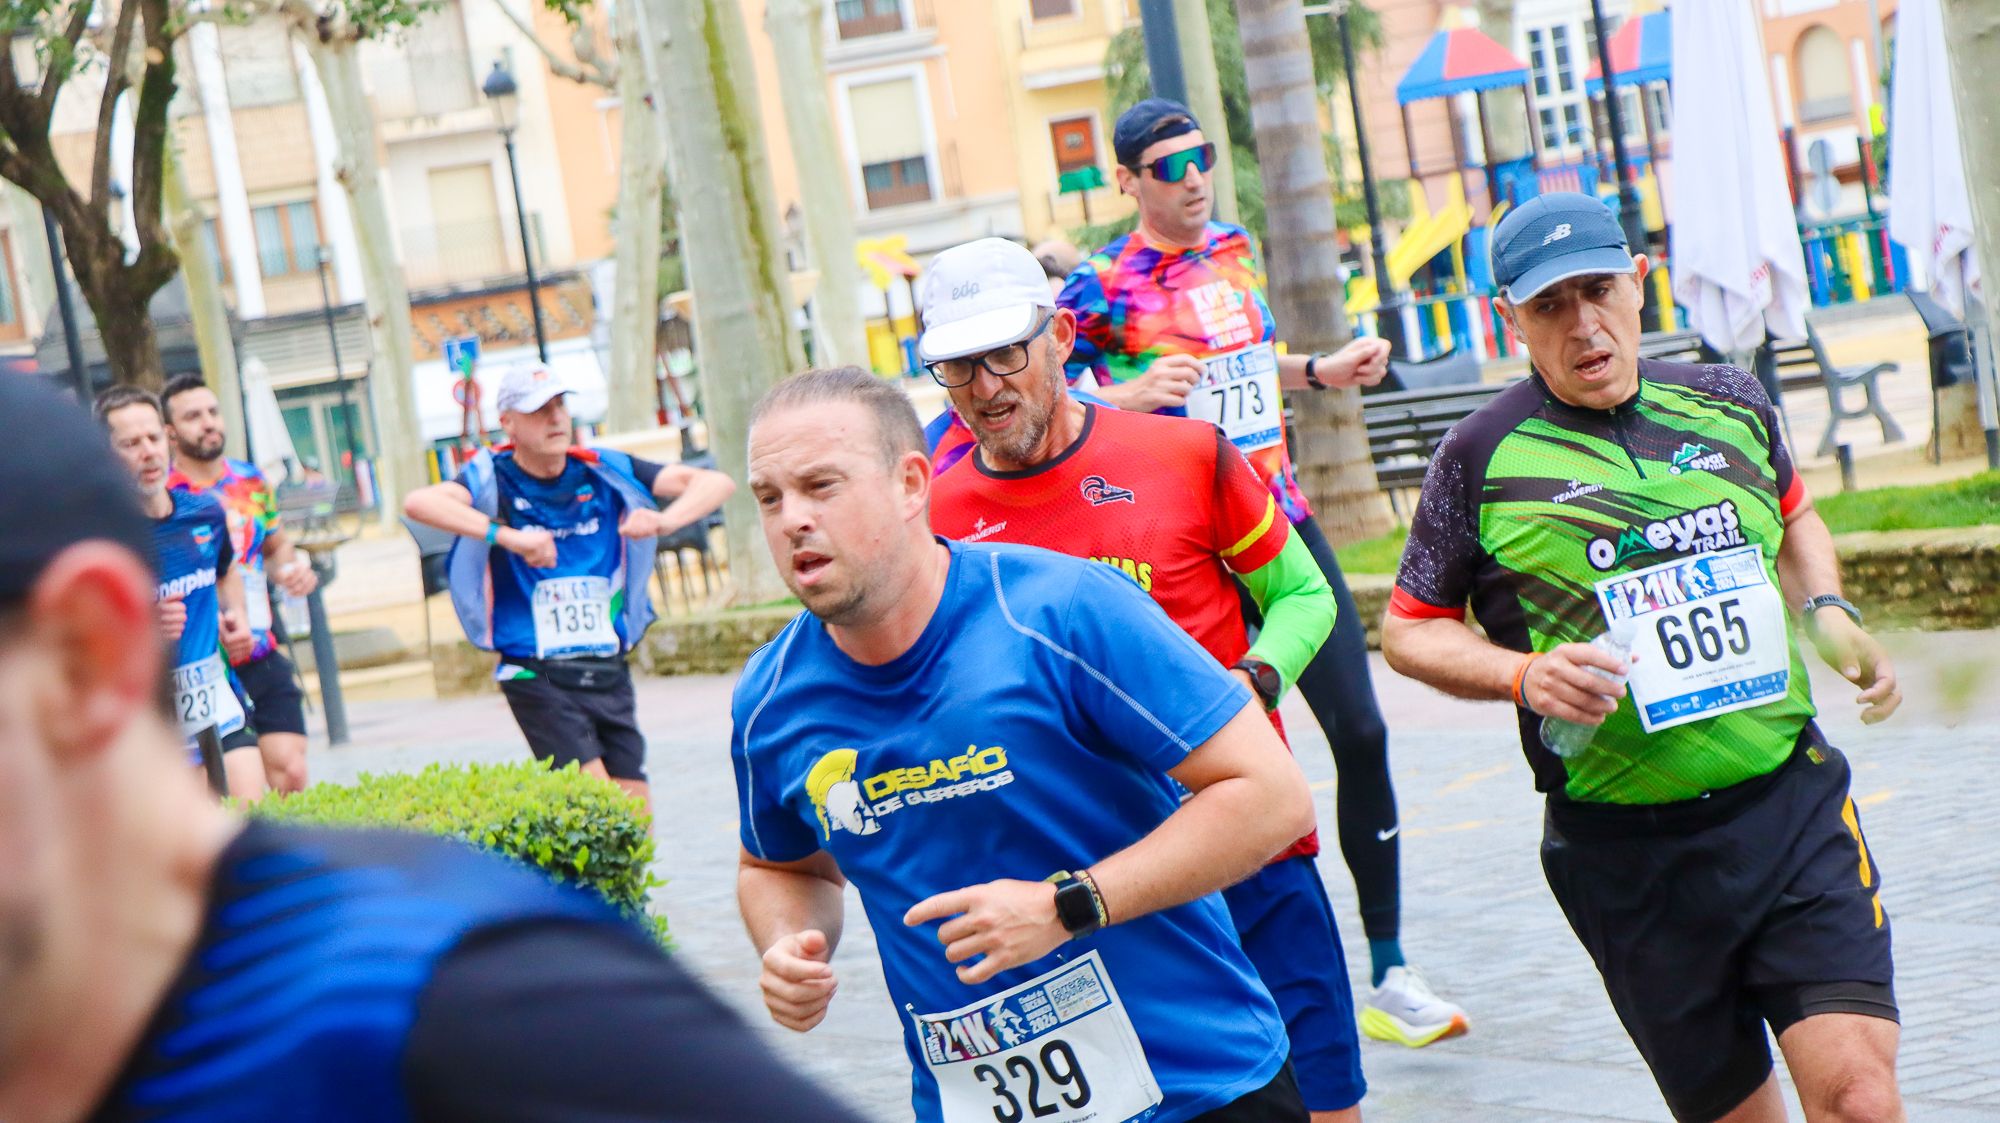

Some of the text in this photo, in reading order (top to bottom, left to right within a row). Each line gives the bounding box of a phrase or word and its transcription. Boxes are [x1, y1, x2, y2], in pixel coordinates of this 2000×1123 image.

[1211, 382, 1264, 424] 773
[1552, 483, 1604, 504] TEAMERGY
[1691, 529, 1746, 554] TRAIL
[1625, 567, 1688, 615] 21K
[1656, 598, 1751, 670] 665
[862, 744, 1008, 801] DESAFÍO
[872, 770, 1015, 817] DE GUERREROS
[933, 1012, 1001, 1063] 21K
[1029, 1011, 1058, 1035] 2026
[973, 1039, 1092, 1123] 329
